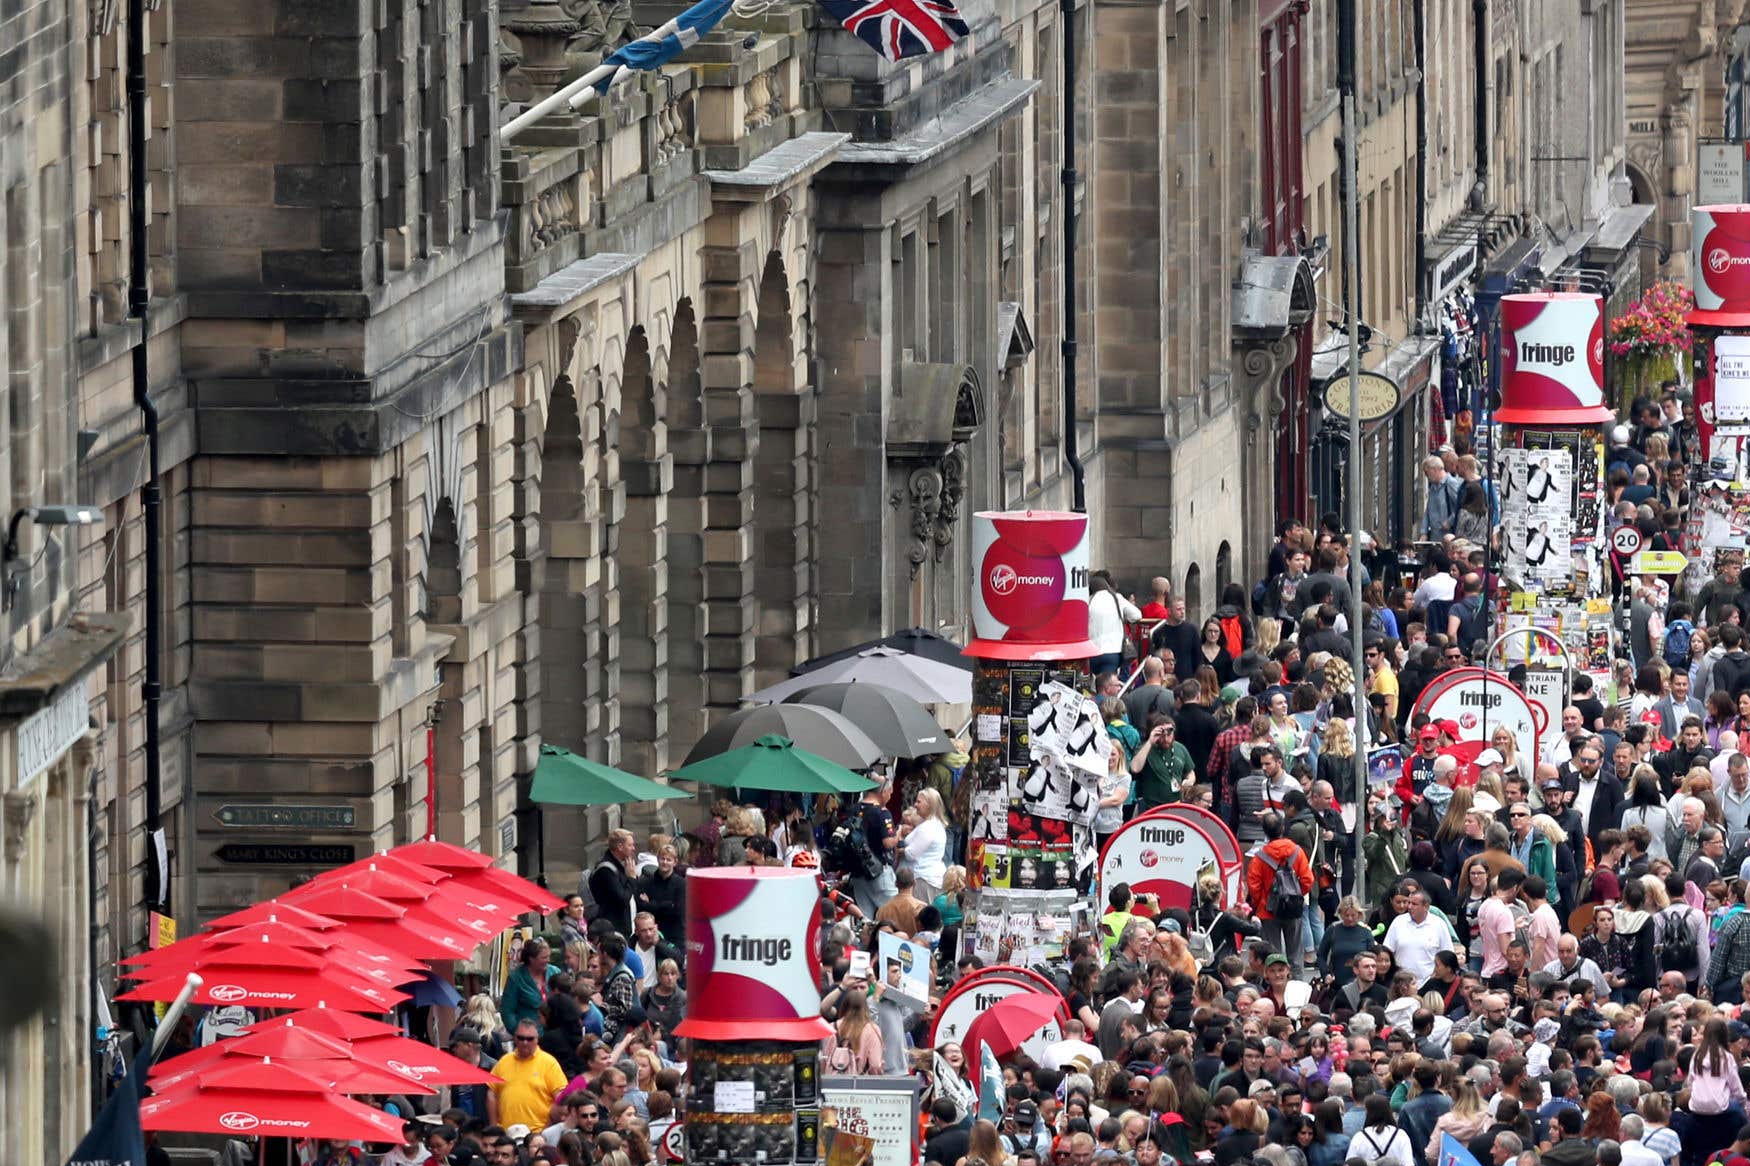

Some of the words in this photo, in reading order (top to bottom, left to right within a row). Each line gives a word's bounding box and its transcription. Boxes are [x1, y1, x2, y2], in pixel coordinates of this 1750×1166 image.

[1710, 250, 1730, 272] Virgin
[1521, 342, 1575, 366] fringe
[1333, 377, 1390, 393] GODON'S
[1331, 398, 1394, 417] TRATORIA
[1616, 535, 1639, 546] 20
[993, 568, 1016, 590] Virgin
[1018, 575, 1054, 587] money
[1460, 690, 1502, 709] fringe
[1140, 826, 1185, 846] fringe
[721, 934, 792, 966] fringe
[248, 989, 297, 1000] money
[260, 1118, 311, 1129] money
[669, 1134, 682, 1148] 2
